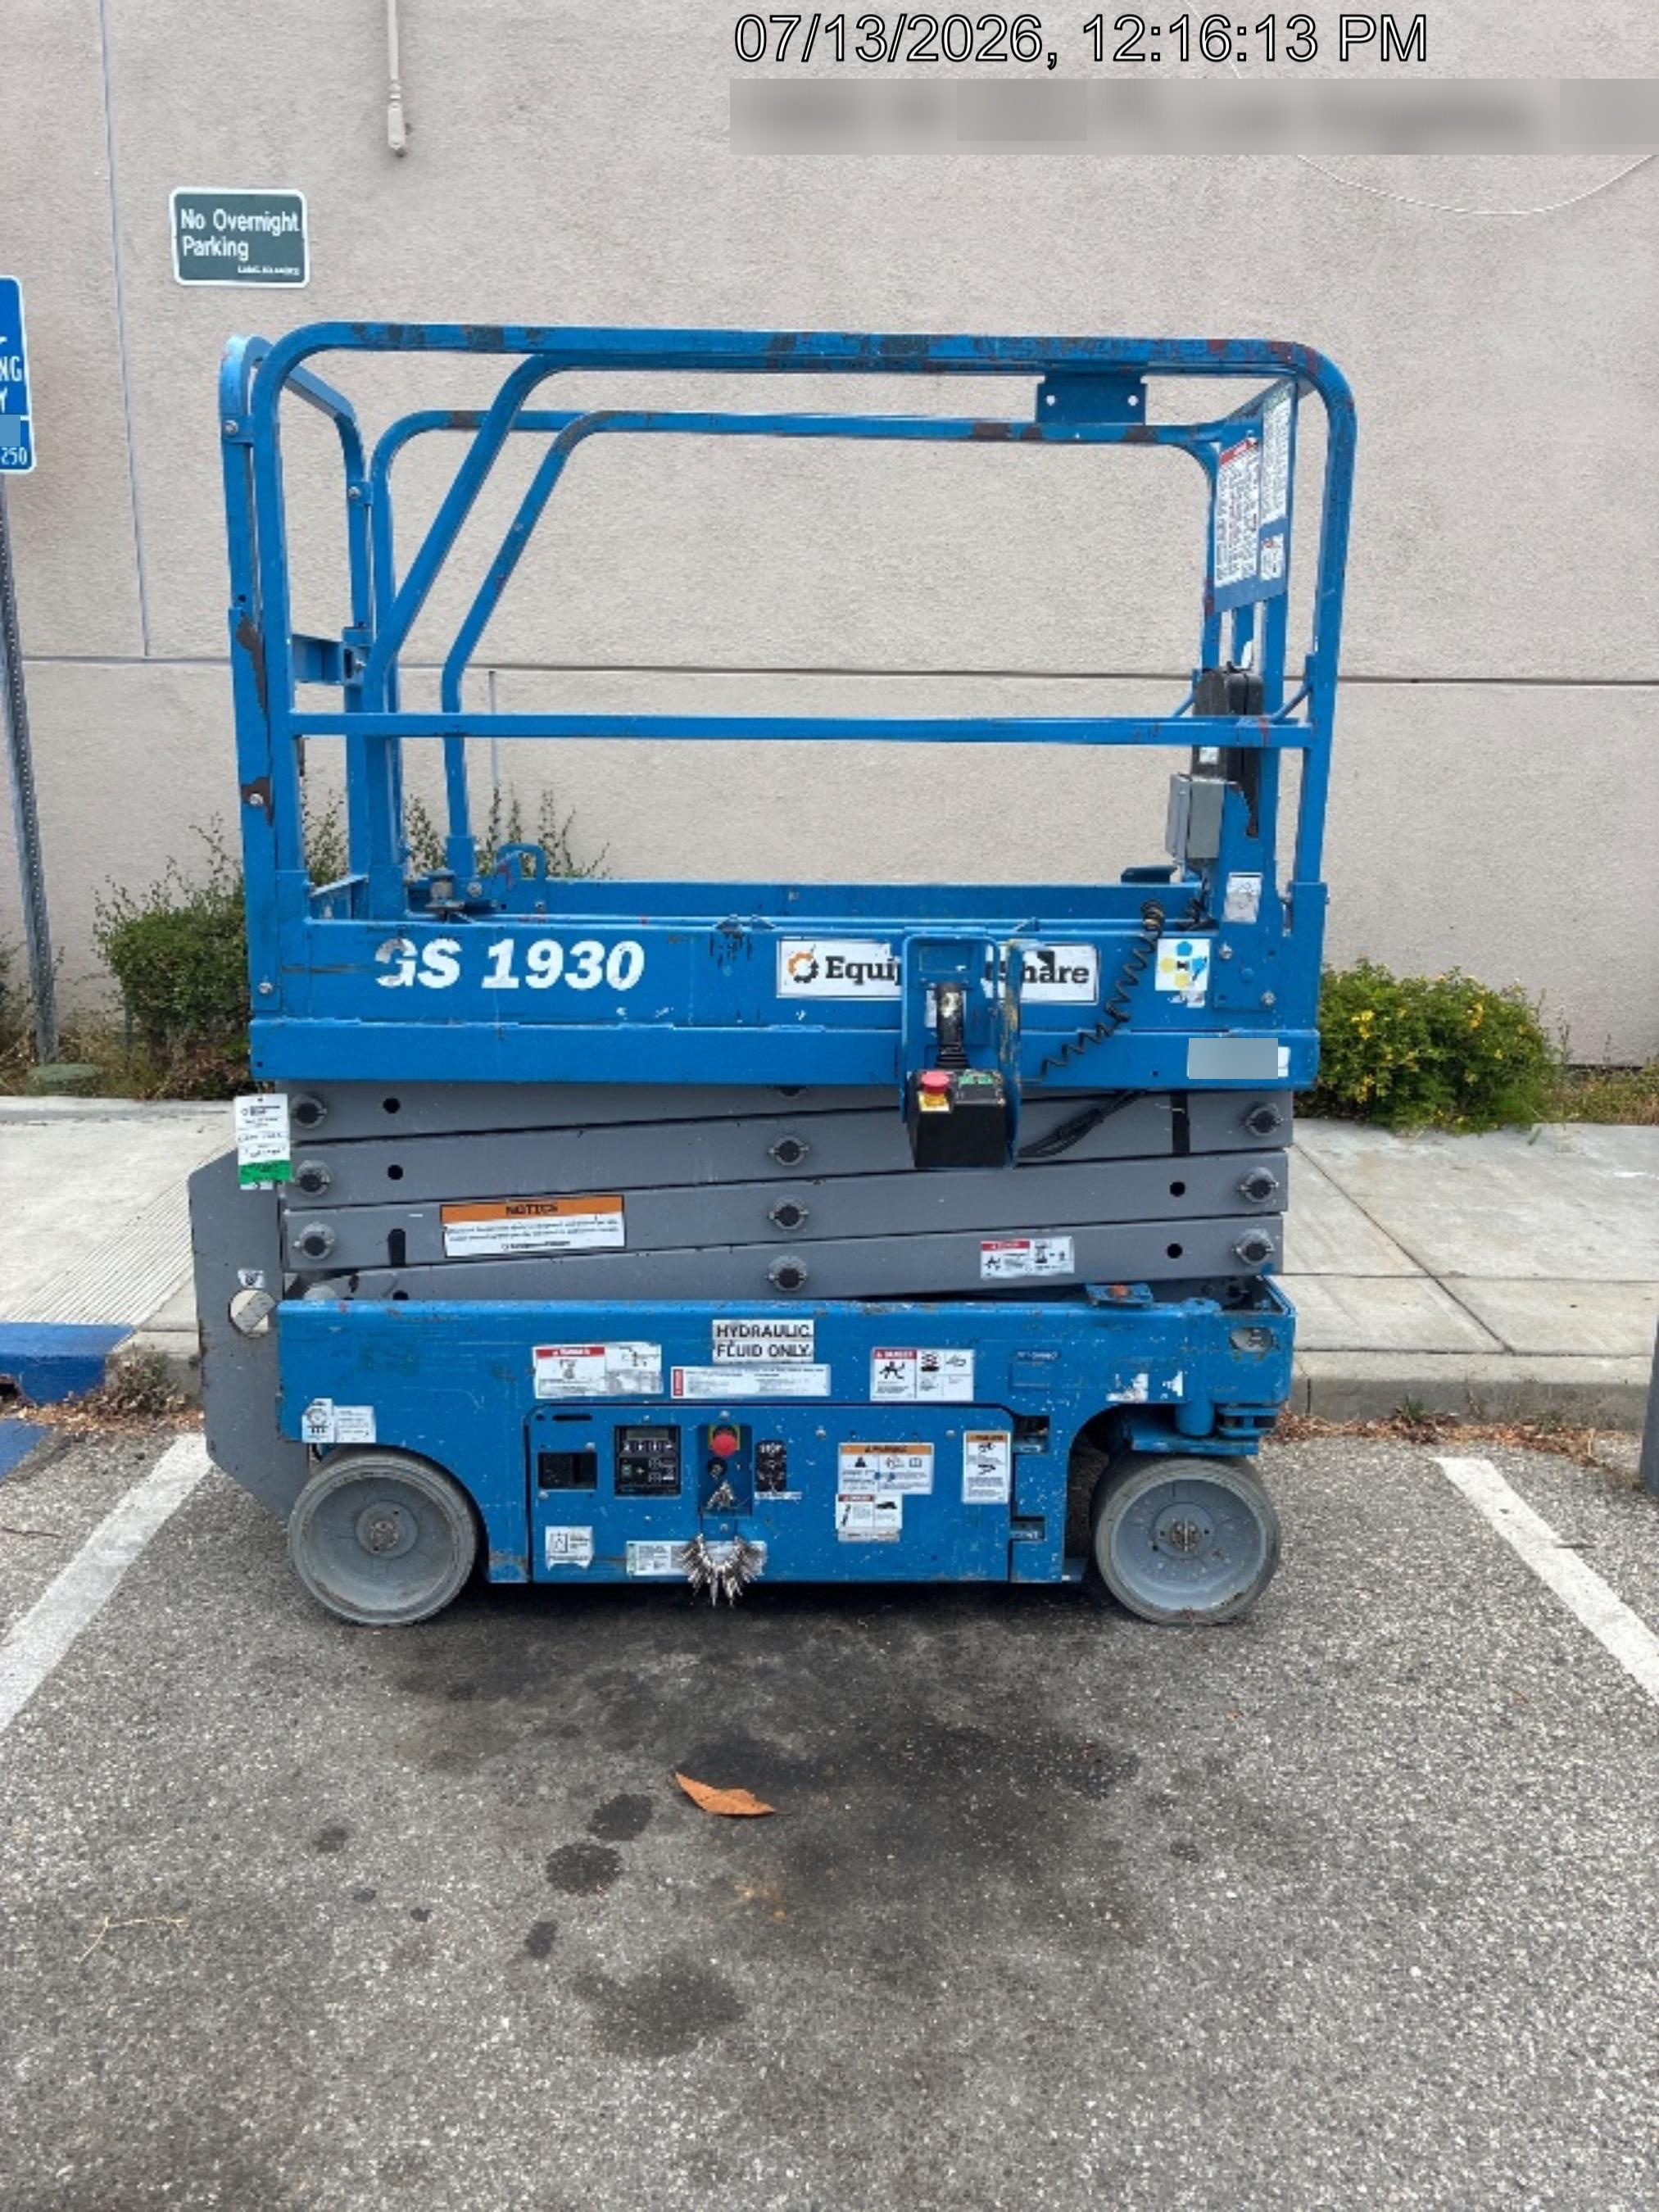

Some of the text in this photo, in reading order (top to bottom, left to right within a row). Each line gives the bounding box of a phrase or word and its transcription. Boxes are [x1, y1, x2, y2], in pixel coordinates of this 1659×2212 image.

[180, 209, 300, 236] No Overnight
[183, 235, 249, 261] Parking
[375, 938, 645, 990] GS 1930
[717, 1323, 811, 1339] HYDRAULIC
[717, 1344, 763, 1358] FLUID
